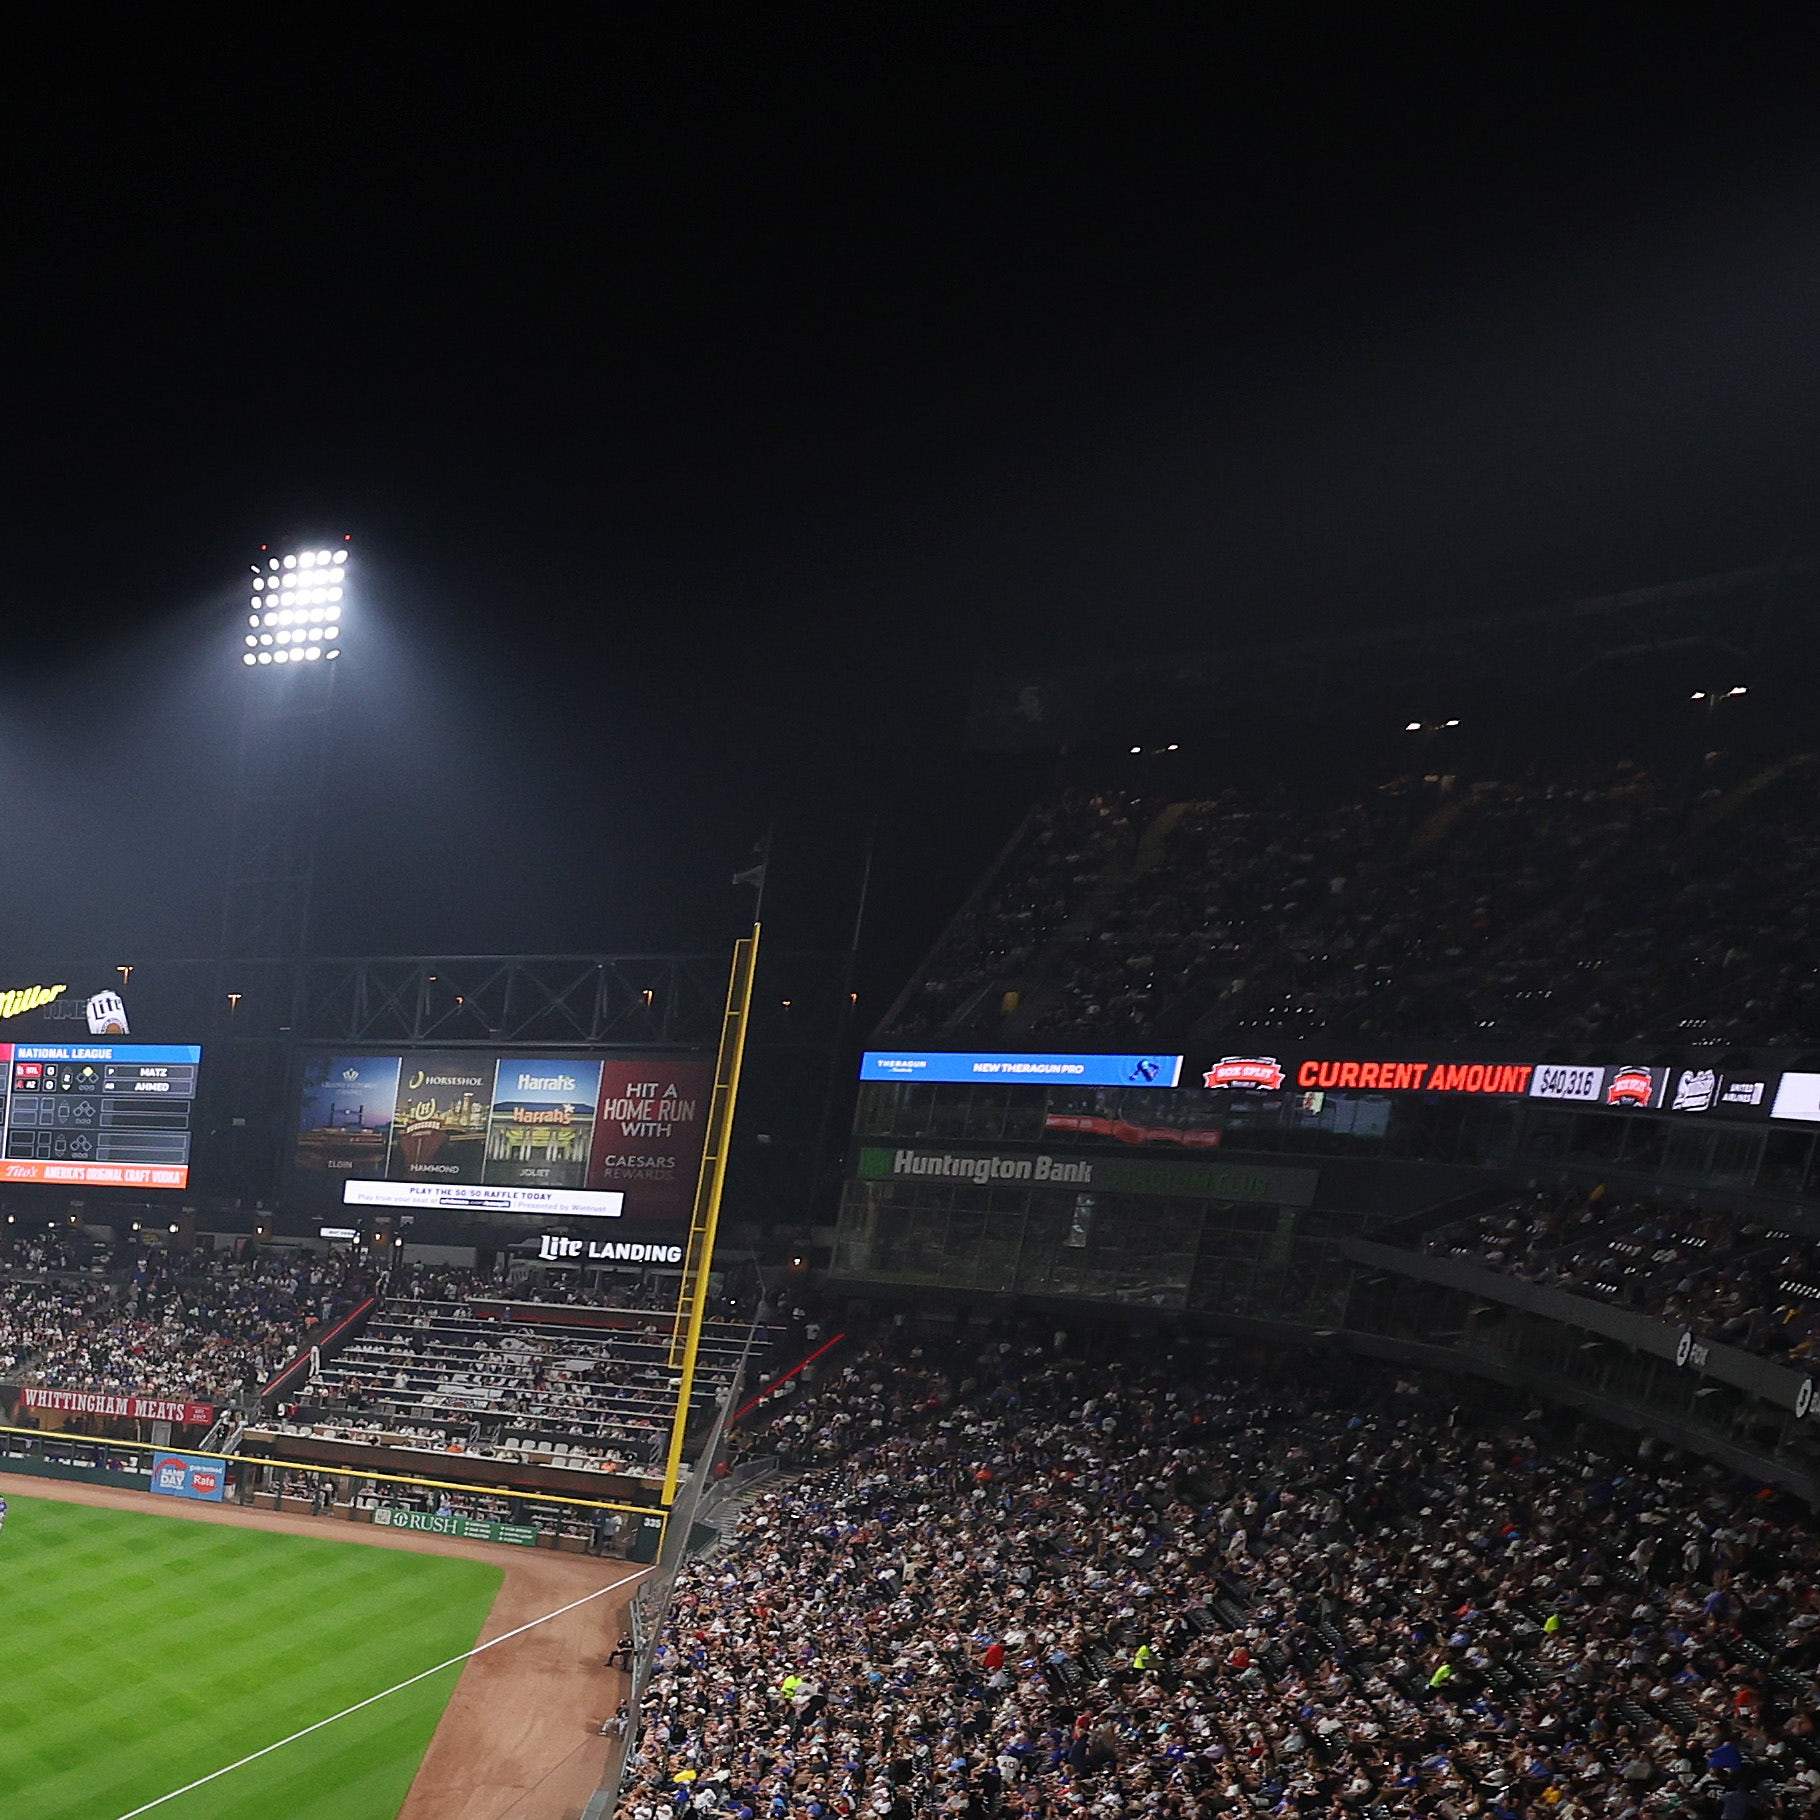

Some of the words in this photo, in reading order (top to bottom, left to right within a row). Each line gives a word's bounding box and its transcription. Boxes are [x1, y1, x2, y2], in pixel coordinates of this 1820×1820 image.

[92, 996, 123, 1020] Lite
[18, 1048, 70, 1058] NATIONAL
[72, 1049, 112, 1059] LEAGUE
[973, 1063, 1000, 1074] NEW
[1001, 1063, 1061, 1074] THERAGUN
[1062, 1064, 1085, 1074] PRO
[1298, 1060, 1429, 1088] CURRENT
[1427, 1064, 1532, 1093] AMOUNT
[1541, 1067, 1594, 1097] $40,316
[626, 1083, 659, 1098] HIT
[663, 1083, 678, 1098] A
[603, 1099, 654, 1121] HOME
[657, 1100, 696, 1122] RUN
[621, 1122, 673, 1138] WITH
[605, 1155, 676, 1168] CAESARS
[894, 1150, 1033, 1185] Huntington
[1034, 1156, 1093, 1184] Bank
[410, 1164, 460, 1174] HAMMOND
[604, 1168, 676, 1180] REWARDS
[538, 1234, 582, 1262] Lite
[589, 1241, 682, 1263] LANDING
[24, 1387, 129, 1416] WHITTINGHAM
[134, 1397, 186, 1422] MEATS
[160, 1467, 185, 1478] SAME
[189, 1464, 223, 1474] guaranteed
[160, 1475, 185, 1489] DAY
[193, 1474, 215, 1487] Rate
[410, 1512, 458, 1535] RUSH
[643, 1517, 661, 1528] 335
